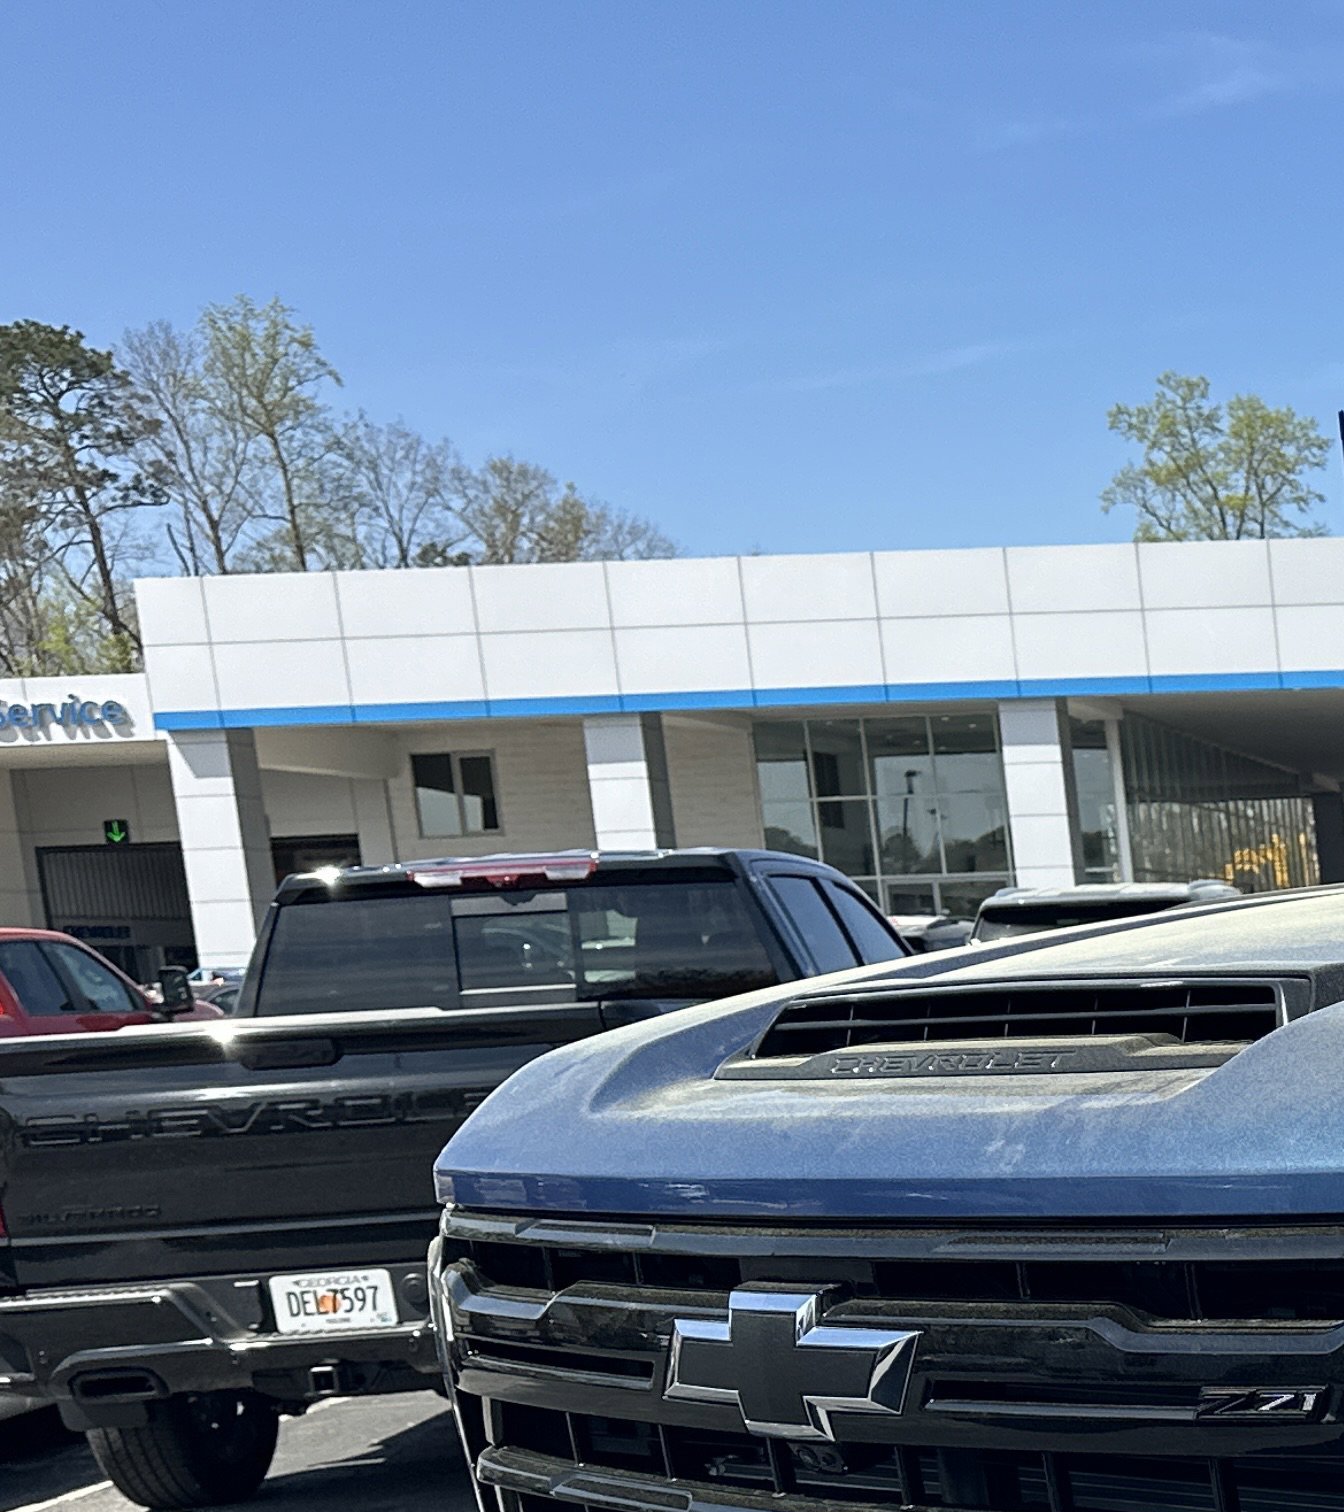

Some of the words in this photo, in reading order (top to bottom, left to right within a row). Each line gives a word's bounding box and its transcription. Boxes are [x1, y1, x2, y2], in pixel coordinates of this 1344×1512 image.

[831, 1050, 1077, 1074] CHEVROLET
[22, 1087, 492, 1147] CHEVROLE
[286, 1286, 378, 1317] DEL7597
[1199, 1384, 1326, 1420] Z71
